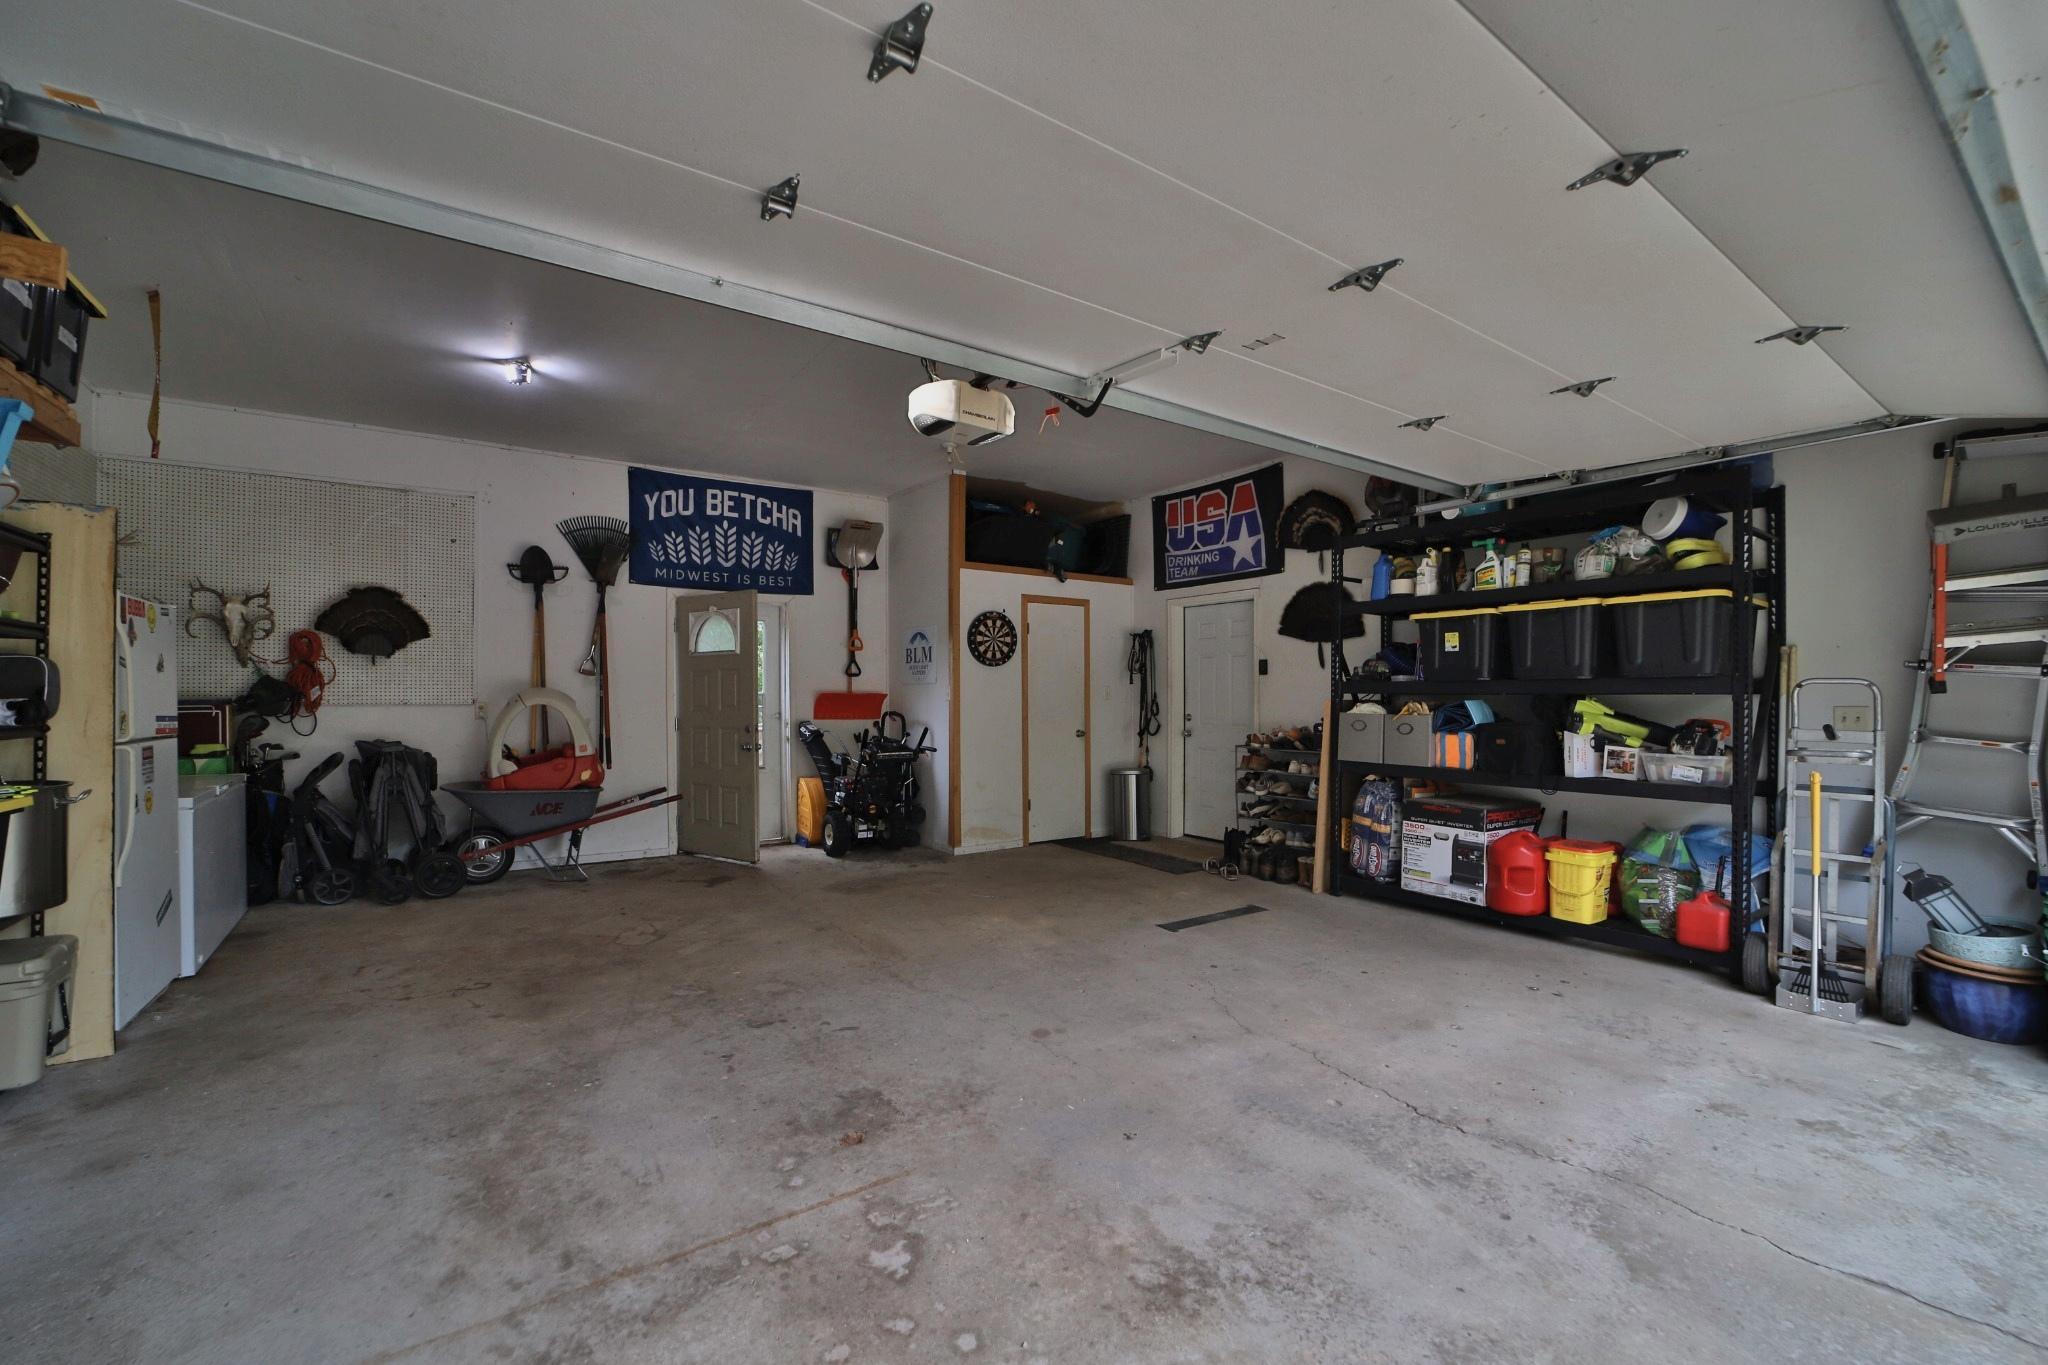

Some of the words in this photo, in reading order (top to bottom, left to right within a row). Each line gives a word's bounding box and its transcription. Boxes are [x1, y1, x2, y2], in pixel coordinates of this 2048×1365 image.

[644, 489, 694, 521] YOU
[706, 489, 802, 537] BETCHA
[1165, 480, 1266, 568] USA
[1168, 551, 1220, 567] DRINKING
[655, 567, 729, 583] MIDWEST
[737, 573, 750, 584] IS
[758, 575, 793, 587] BEST
[1168, 566, 1199, 579] TEAM
[905, 646, 932, 664] BLM
[529, 802, 565, 816] ACE
